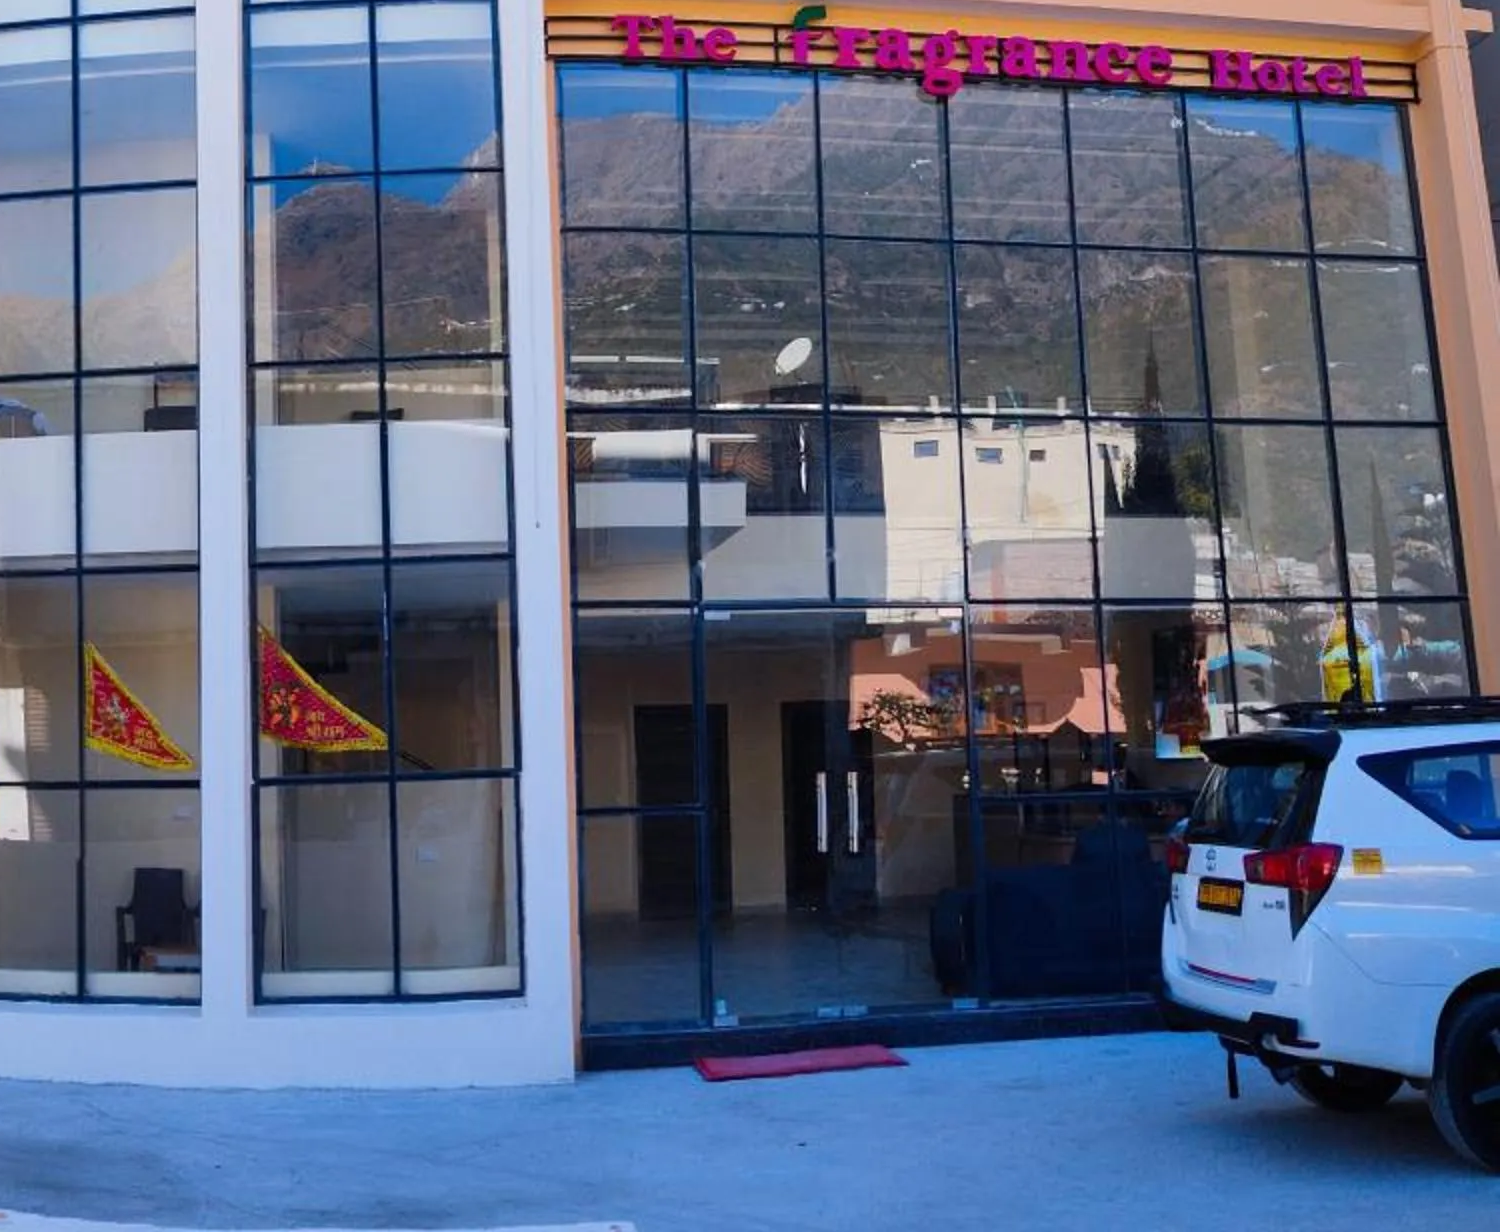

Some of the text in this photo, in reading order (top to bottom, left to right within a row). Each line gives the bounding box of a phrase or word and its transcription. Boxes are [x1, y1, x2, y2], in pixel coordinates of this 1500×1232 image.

[611, 5, 1367, 97] The fragrance Hotel
